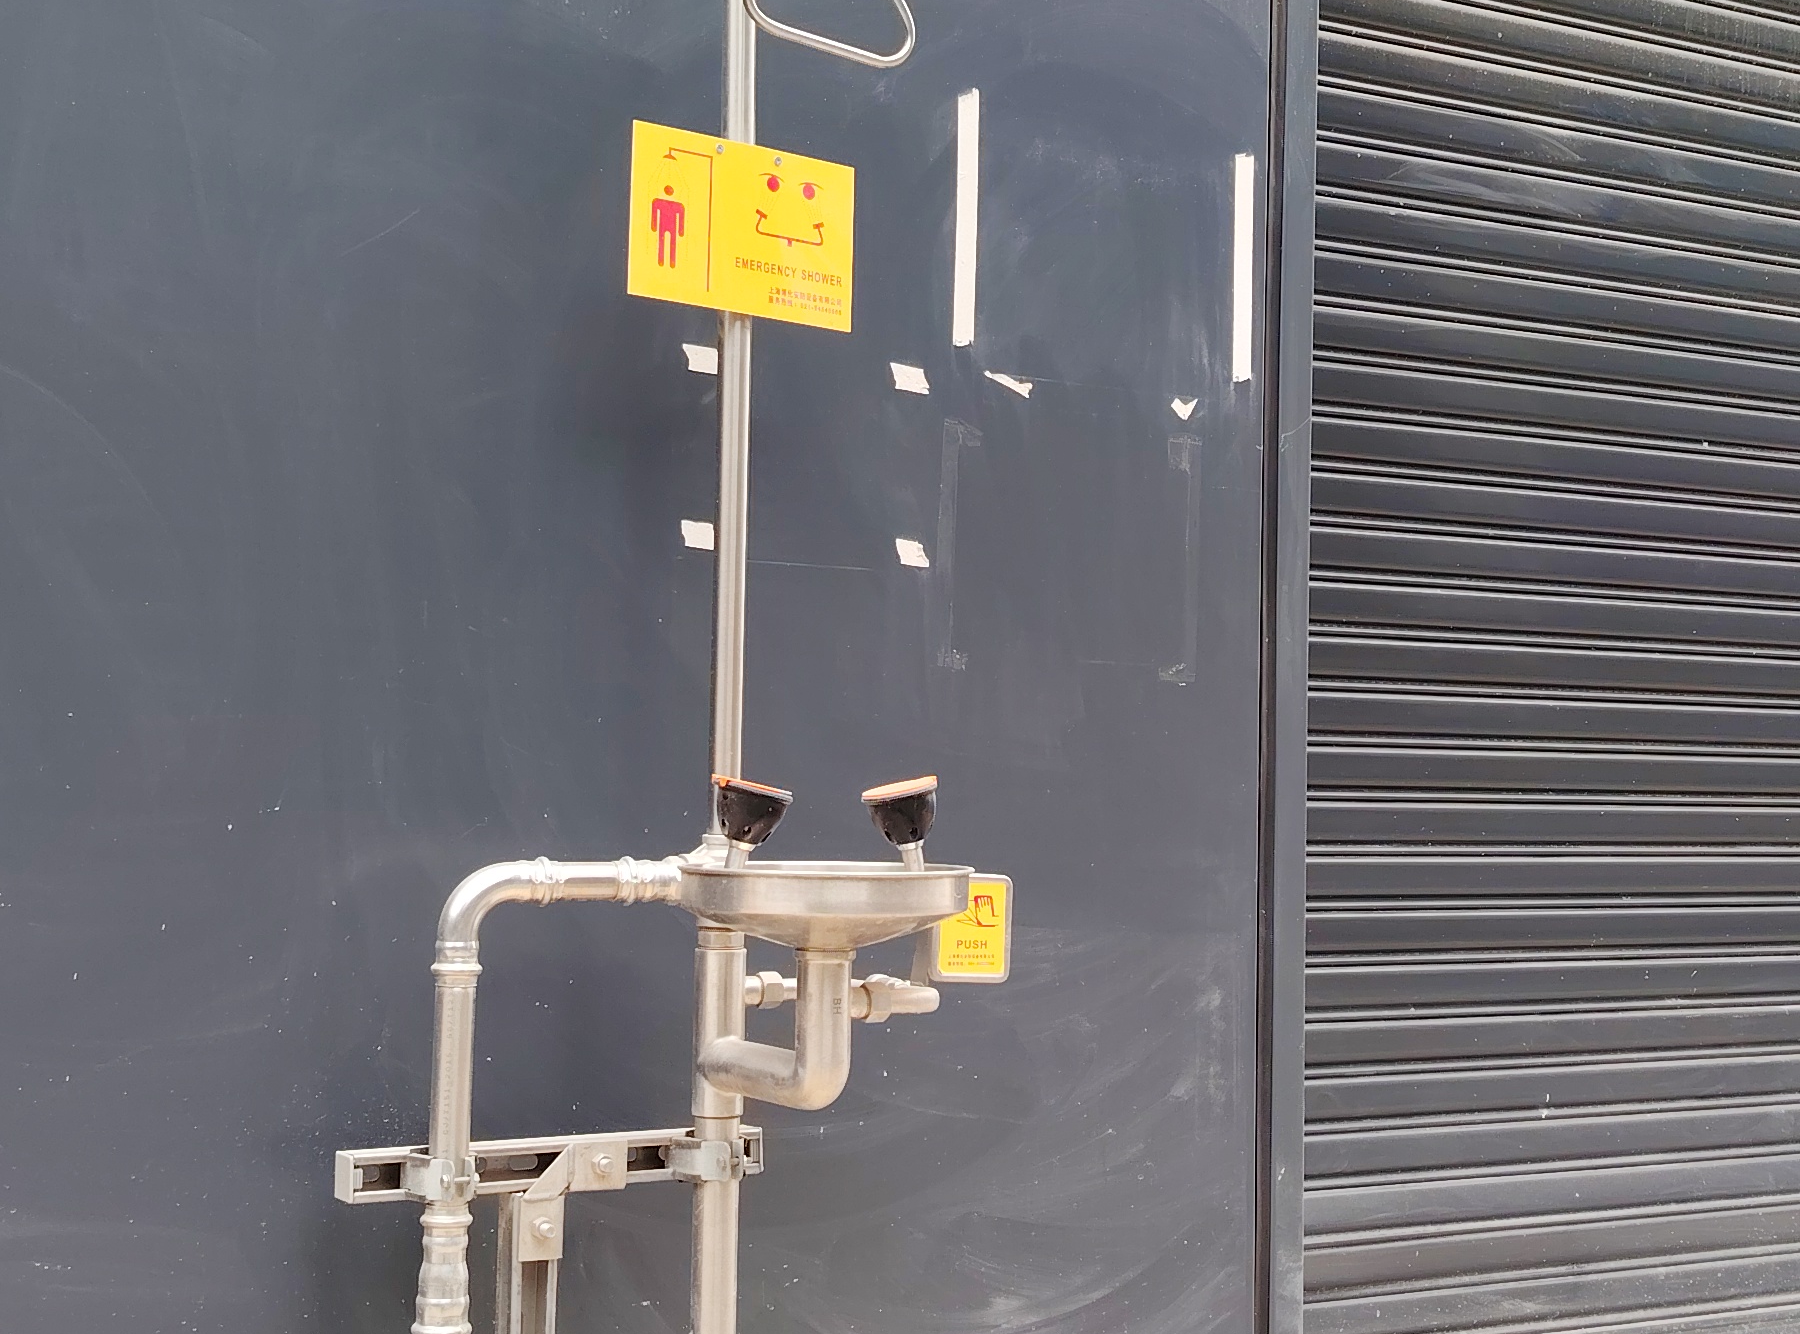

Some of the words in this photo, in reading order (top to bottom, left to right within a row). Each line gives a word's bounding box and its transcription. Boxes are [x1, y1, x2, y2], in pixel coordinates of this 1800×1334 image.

[735, 257, 797, 278] EMERGENCY
[801, 269, 842, 287] SHOWER
[956, 939, 987, 949] PUSH
[833, 998, 842, 1015] BH
